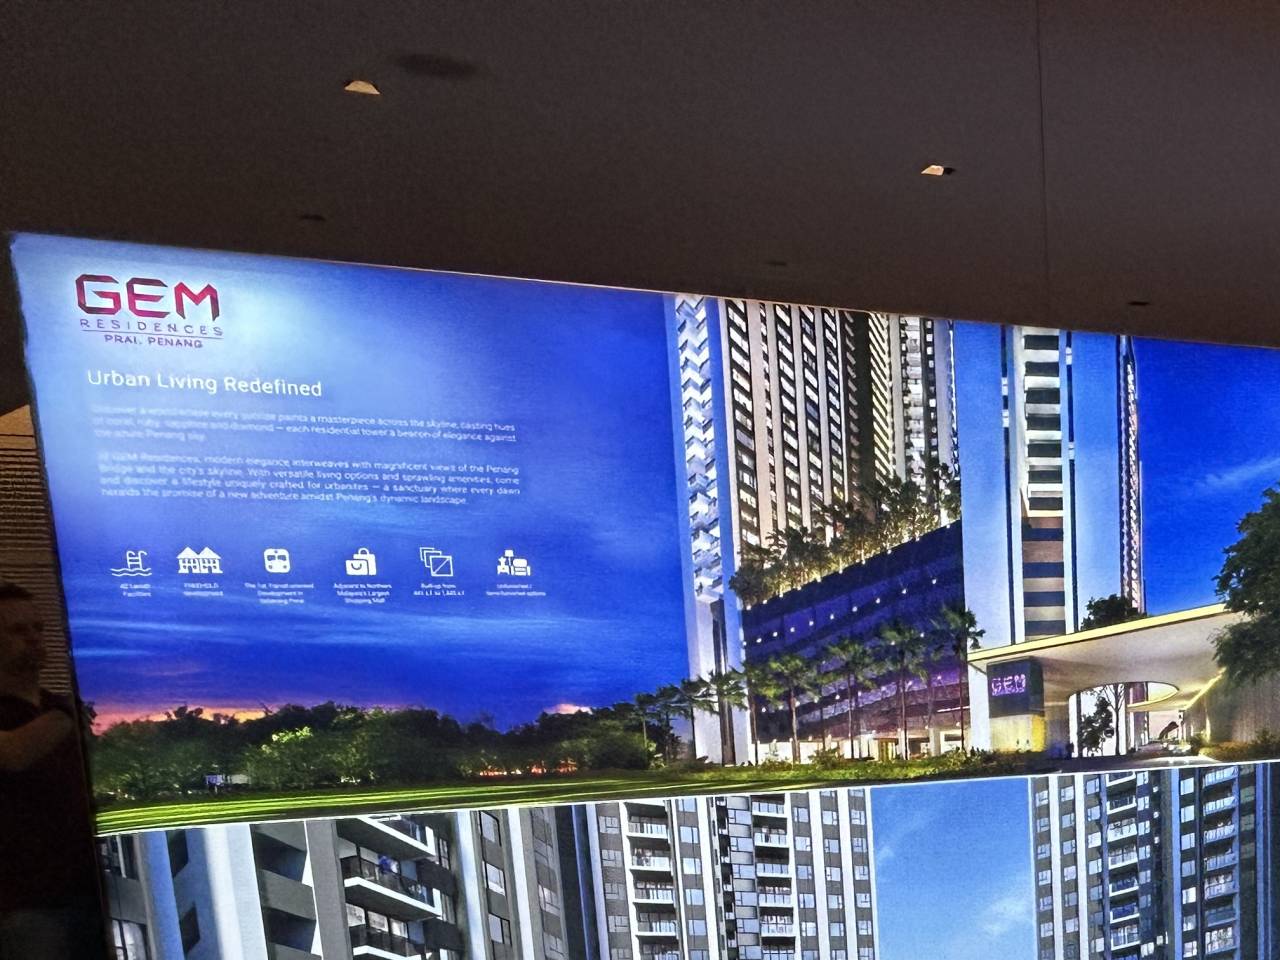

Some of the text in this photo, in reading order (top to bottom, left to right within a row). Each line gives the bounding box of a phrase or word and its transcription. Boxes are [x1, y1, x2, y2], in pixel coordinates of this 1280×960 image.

[75, 274, 220, 322] GEM
[80, 318, 224, 336] RESIDENCES
[149, 337, 203, 349] PENANG
[88, 370, 322, 397] Urban Living Redefined
